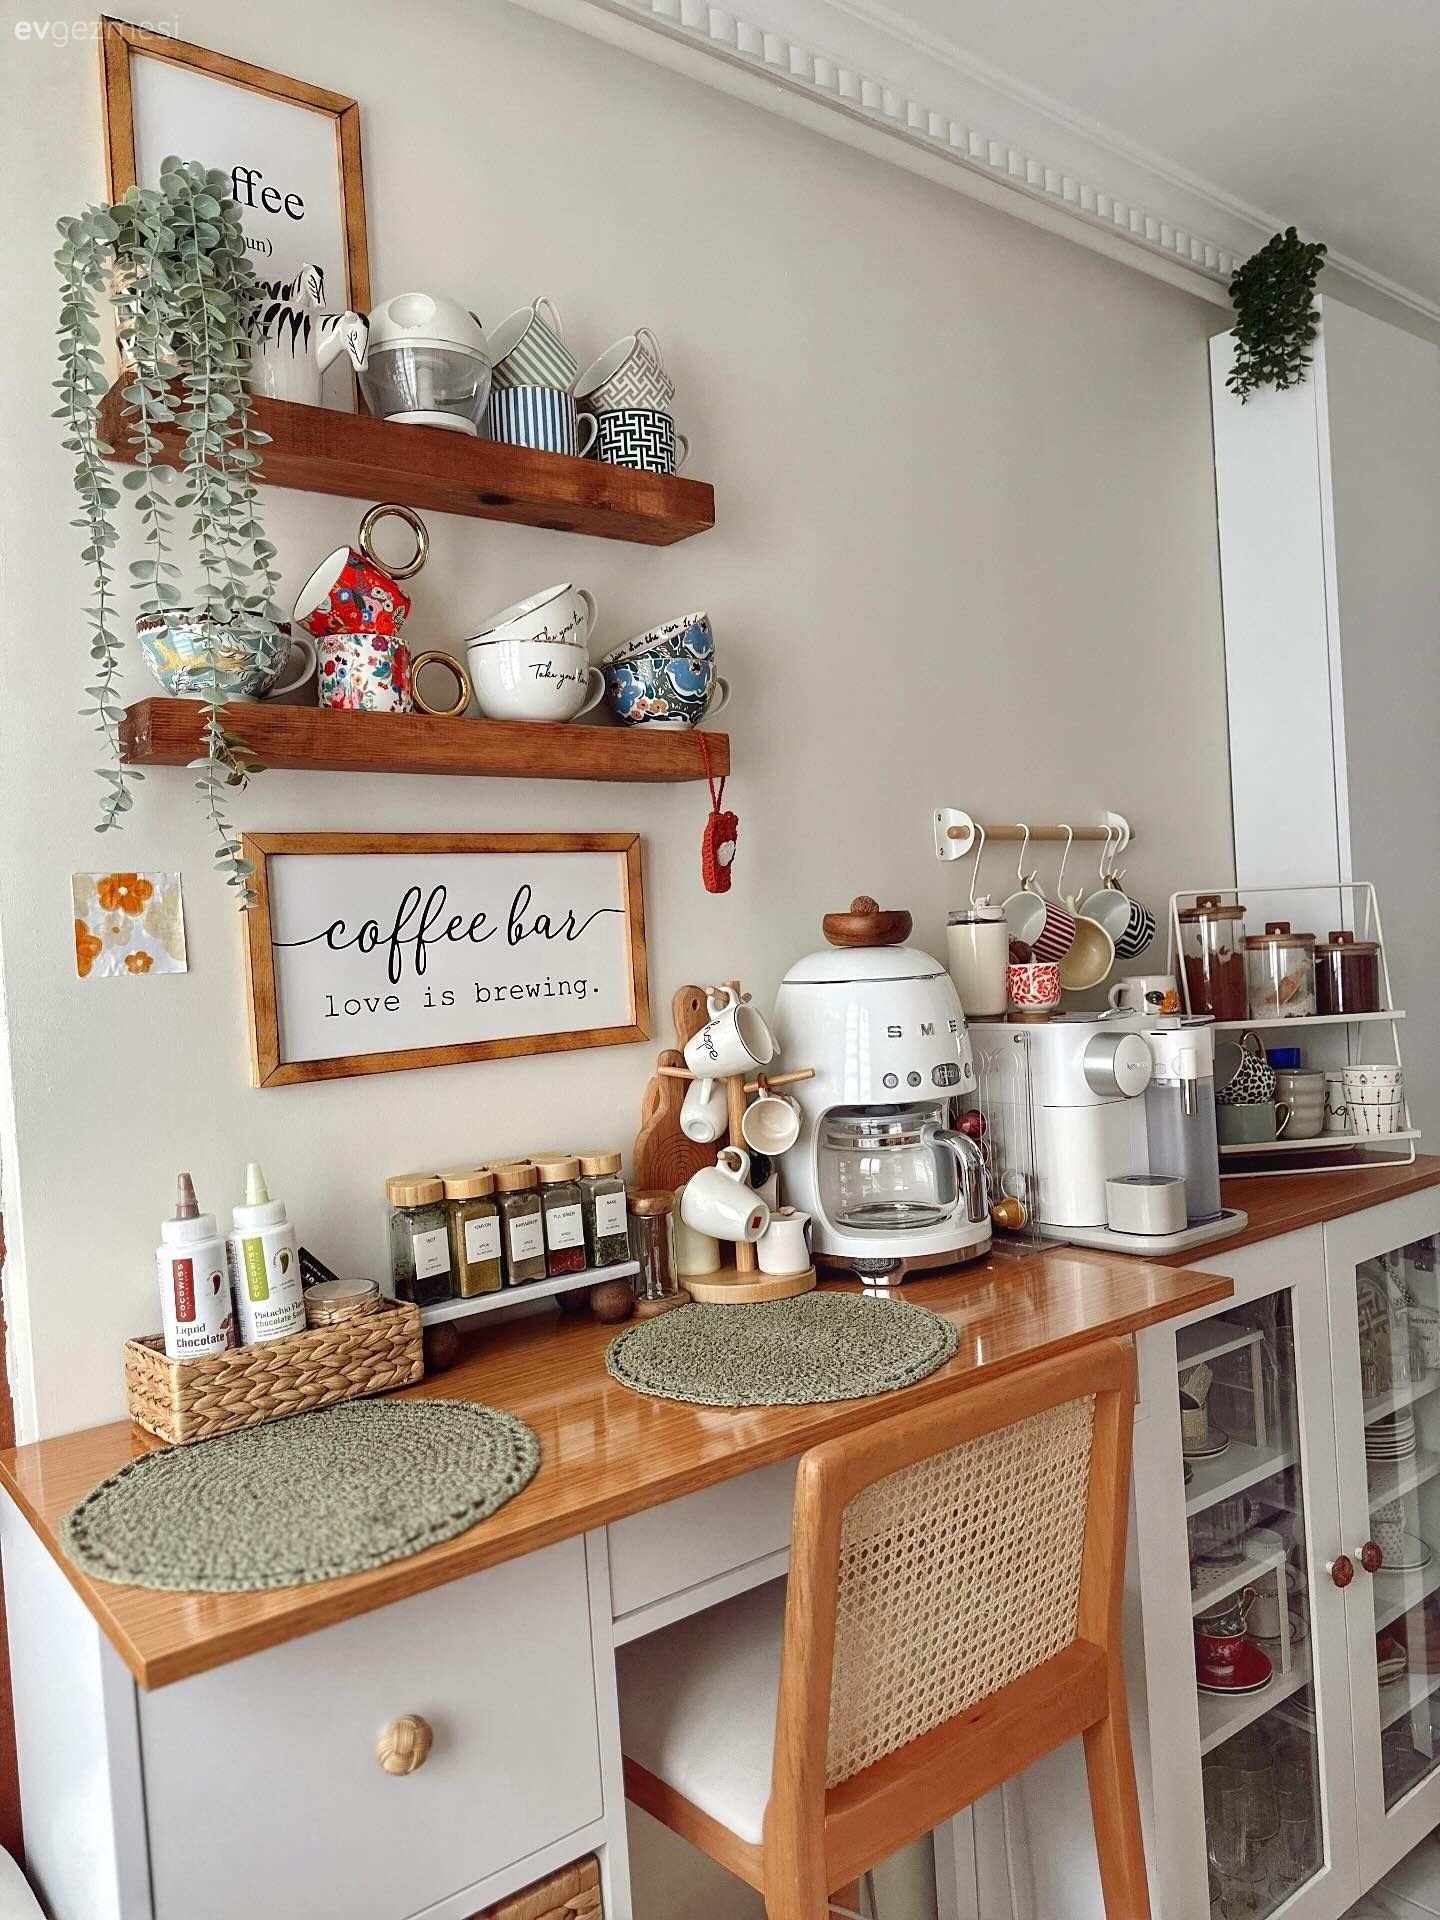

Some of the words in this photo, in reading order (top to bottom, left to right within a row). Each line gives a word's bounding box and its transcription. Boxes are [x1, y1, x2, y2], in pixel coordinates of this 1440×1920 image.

[230, 165, 305, 221] ffee
[528, 660, 557, 679] Take
[272, 884, 497, 984] coffee
[507, 883, 625, 946] bar
[324, 994, 401, 1019] love
[422, 986, 456, 1009] is
[474, 976, 600, 1004] brewing.
[254, 1305, 291, 1320] Pistachio
[176, 1323, 206, 1337] Liquid
[255, 1315, 292, 1328] Chocolate
[176, 1332, 225, 1348] Chocolate
